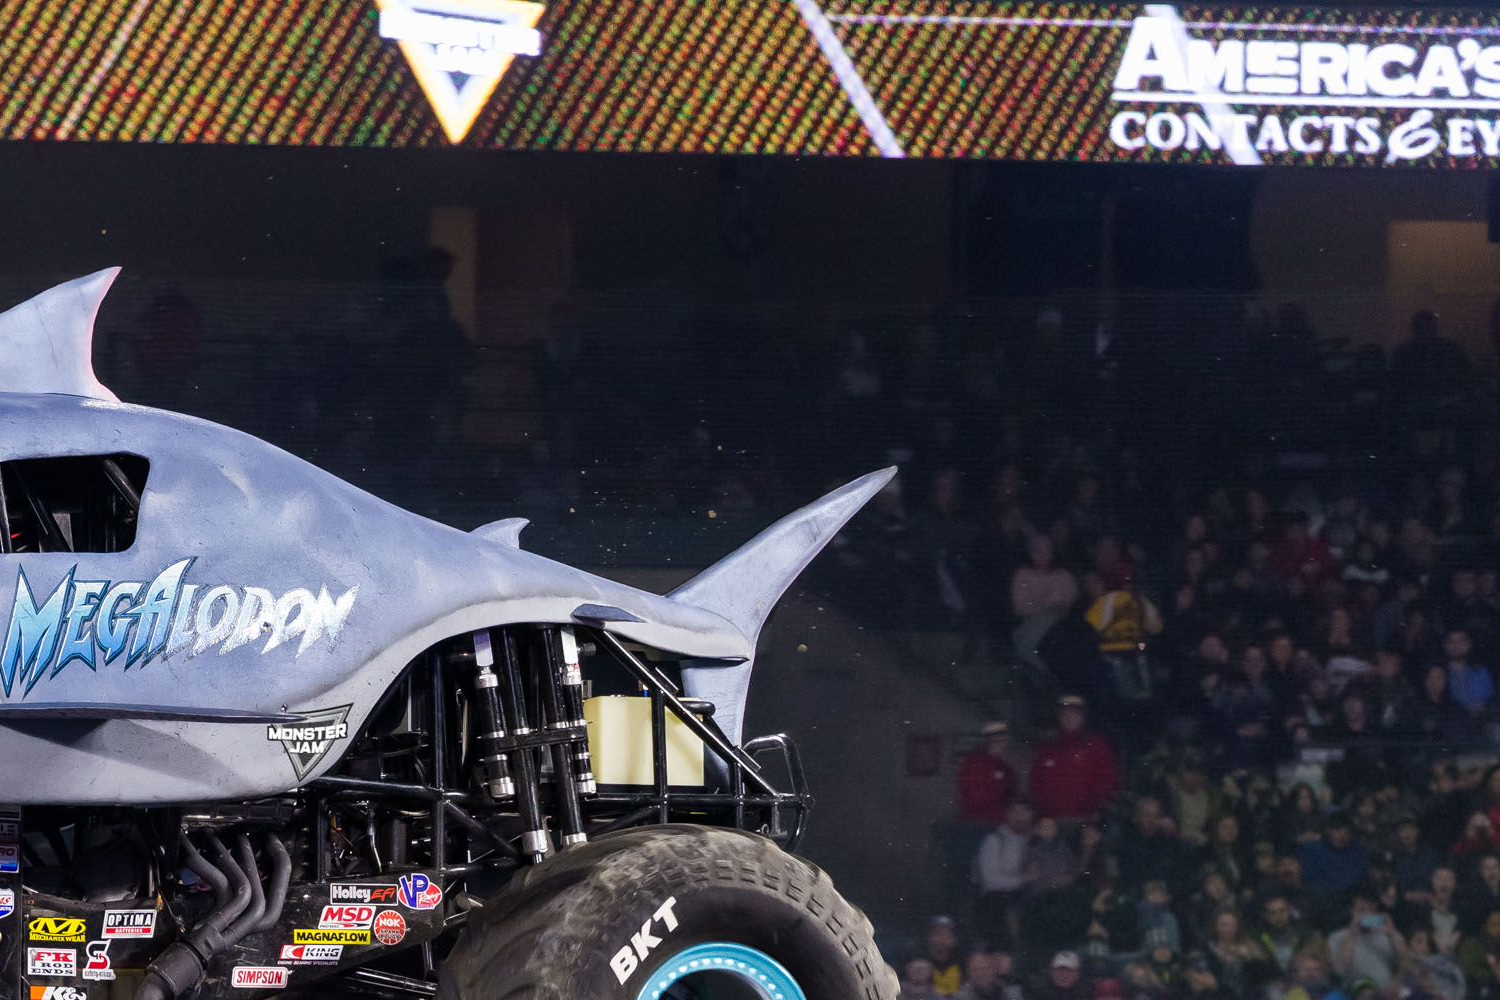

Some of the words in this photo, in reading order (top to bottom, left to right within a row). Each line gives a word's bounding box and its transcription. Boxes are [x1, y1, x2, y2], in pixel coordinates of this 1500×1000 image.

[1109, 111, 1382, 155] CONTACTS
[0, 556, 362, 700] MEGALODON
[268, 721, 348, 742] MONSTER
[289, 739, 326, 755] JAM
[332, 885, 372, 903] Holley
[399, 873, 430, 909] VP
[107, 913, 152, 927] OPTIMA
[322, 907, 373, 922] MSD
[379, 917, 401, 928] NGK
[29, 932, 65, 942] MECHANIX
[65, 935, 86, 943] WEAR
[296, 931, 369, 944] MAGNAFLOW
[608, 896, 680, 986] BKT
[35, 951, 73, 962] FK
[305, 947, 340, 958] KING
[236, 969, 283, 985] SIMPSON
